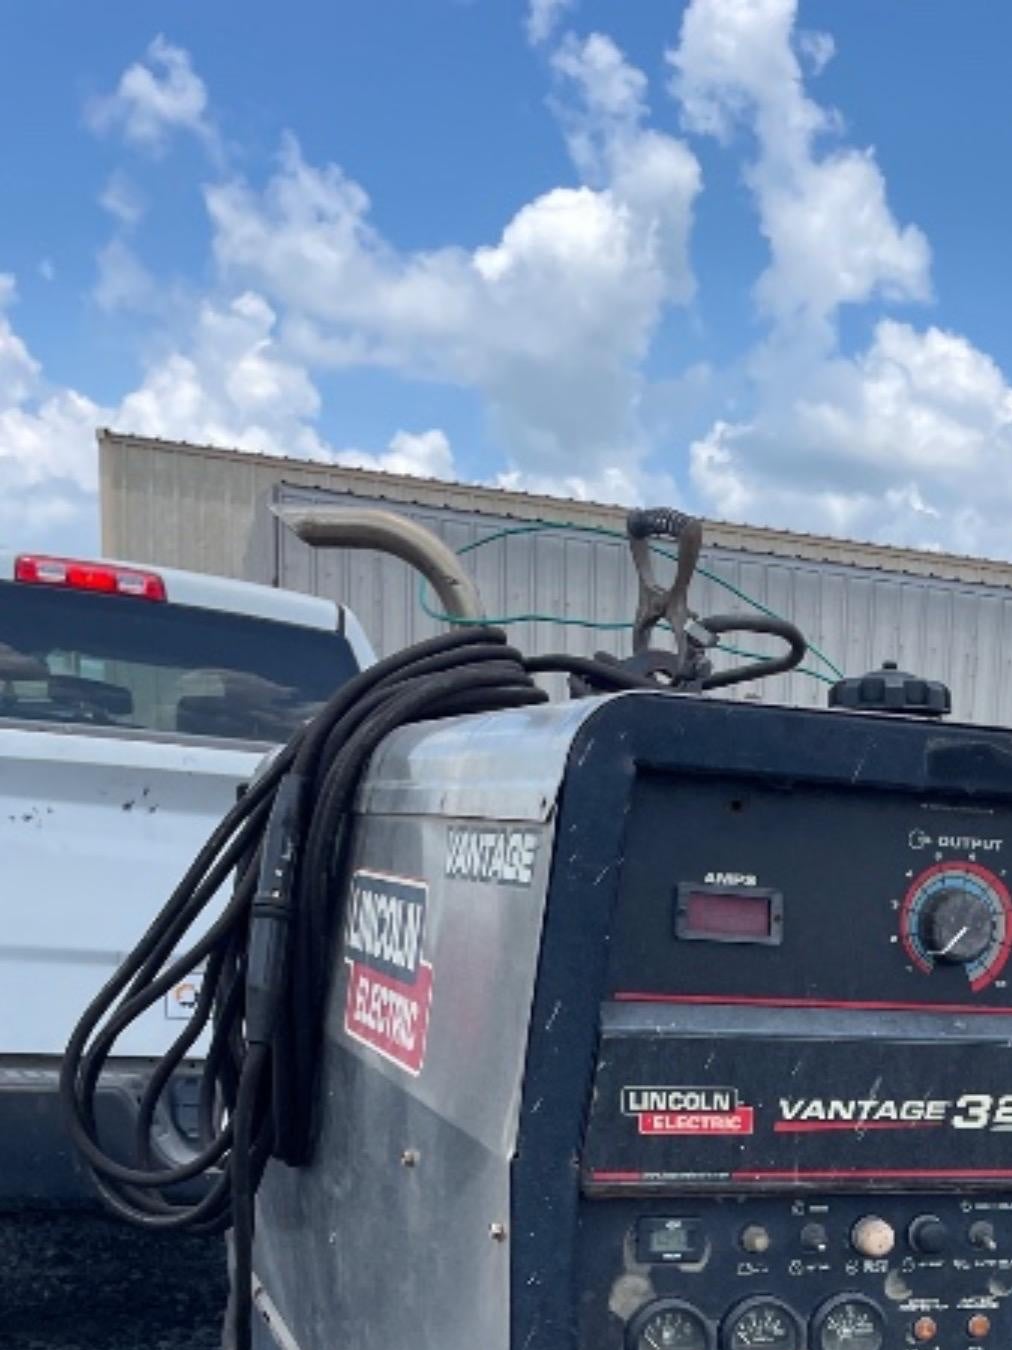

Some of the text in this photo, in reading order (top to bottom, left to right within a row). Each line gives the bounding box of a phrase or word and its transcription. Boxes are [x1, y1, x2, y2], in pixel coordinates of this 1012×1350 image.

[938, 836, 1003, 852] OUTPUT
[446, 832, 538, 883] VANTAGE
[704, 867, 757, 886] AMPS
[350, 884, 423, 972] LINCOLN
[354, 976, 418, 1051] ELECTRIC
[629, 1091, 730, 1111] LINCOLN
[778, 1100, 950, 1121] VANTAGE
[652, 1116, 742, 1130] ELECTRIC
